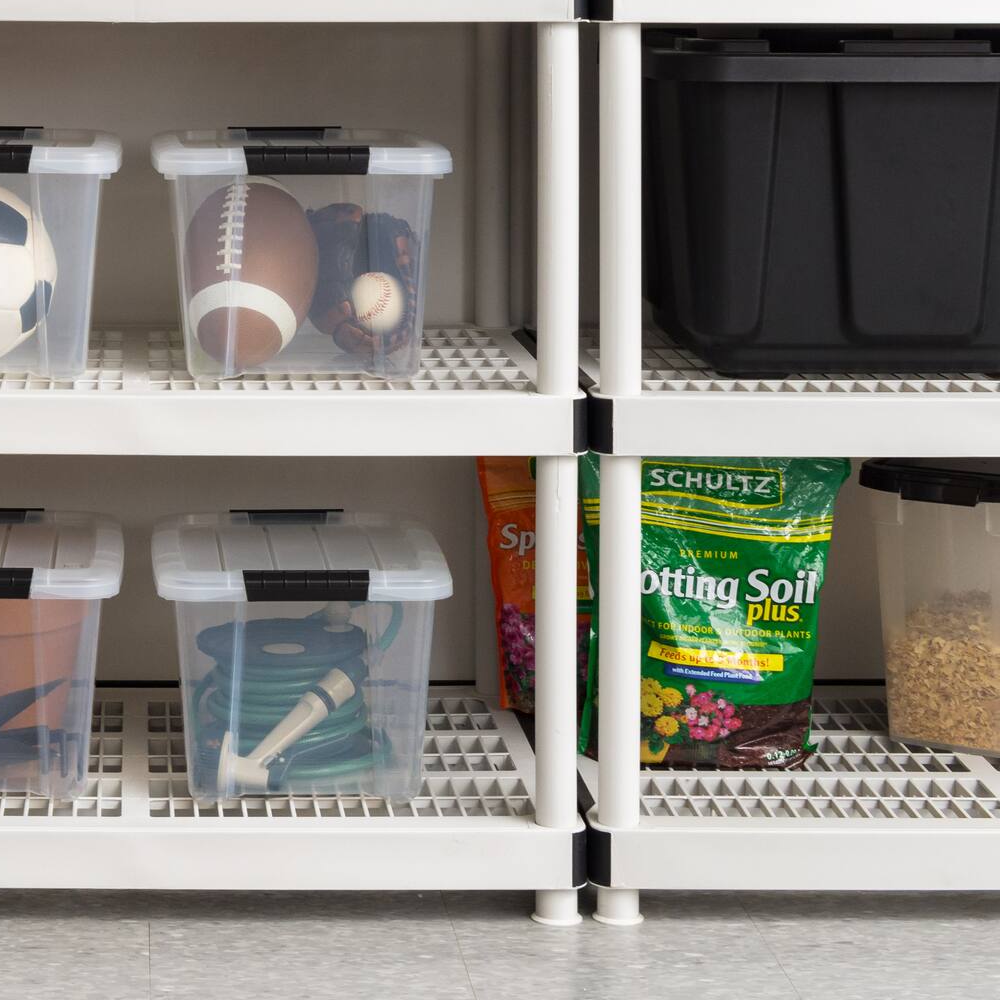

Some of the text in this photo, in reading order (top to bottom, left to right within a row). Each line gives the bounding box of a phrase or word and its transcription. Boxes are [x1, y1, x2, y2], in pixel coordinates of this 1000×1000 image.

[650, 468, 775, 494] SCHULTZ
[680, 549, 738, 560] PREMIUM
[641, 566, 817, 610] otting Soil
[746, 598, 800, 626] plus
[679, 624, 713, 634] INDOOR
[725, 627, 772, 638] OUTDOOR
[775, 630, 811, 639] PLANTS
[660, 647, 686, 662] Feeds
[689, 655, 701, 664] up
[672, 666, 684, 674] with
[684, 668, 710, 677] Extended
[710, 669, 724, 678] Feed
